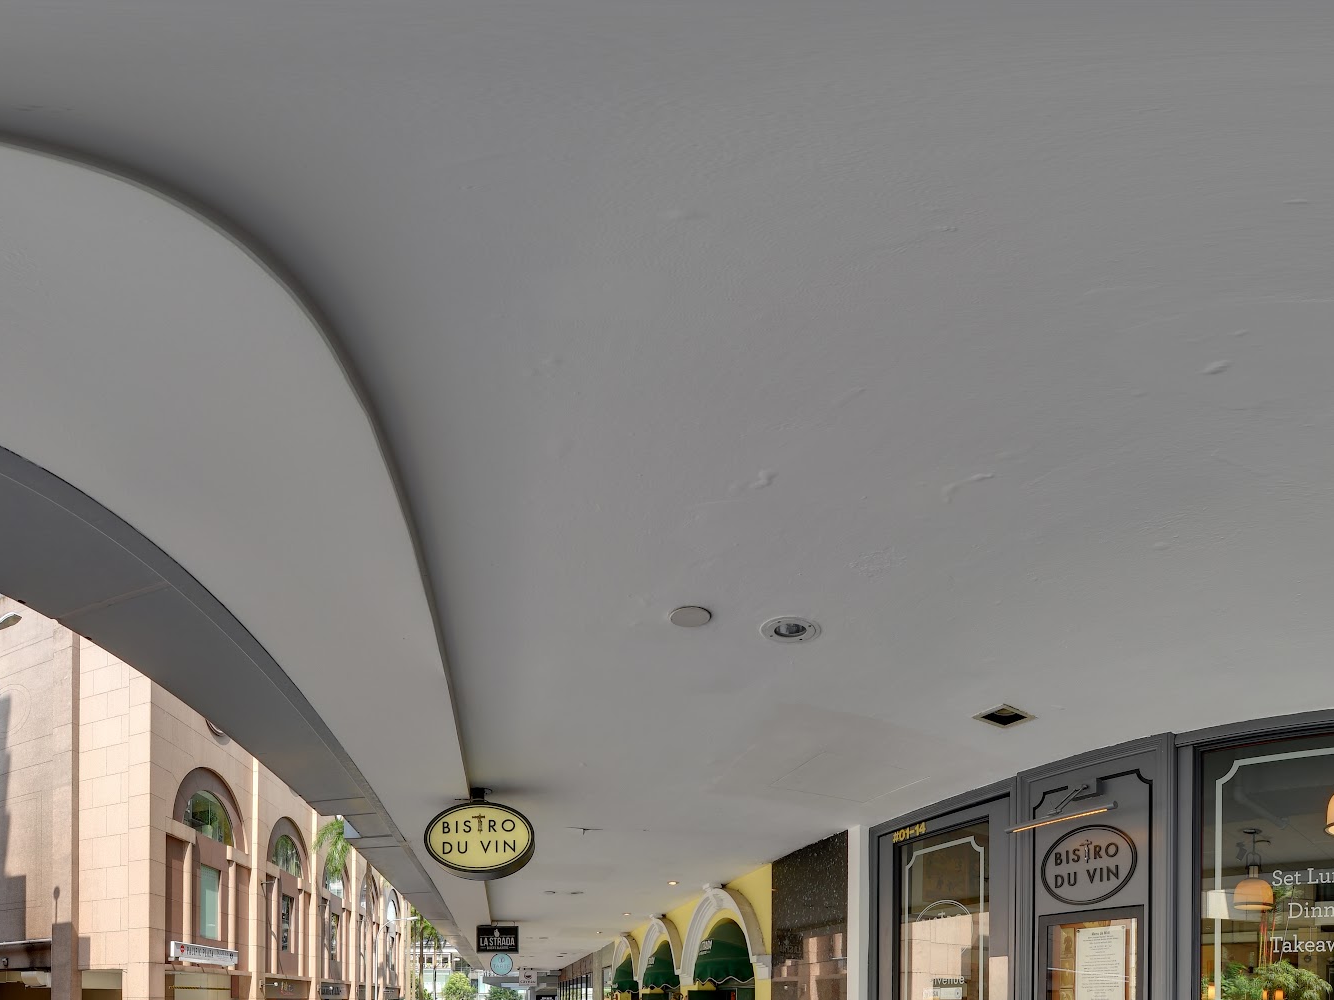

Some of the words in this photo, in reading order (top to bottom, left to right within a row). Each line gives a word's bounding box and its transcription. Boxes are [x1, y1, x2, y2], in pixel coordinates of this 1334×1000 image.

[442, 813, 516, 834] BISTRO
[892, 822, 926, 843] #01-14
[442, 841, 468, 854] DU
[480, 840, 516, 853] VIN
[1054, 839, 1119, 867] BISTRO
[1054, 872, 1077, 889] DU
[1086, 865, 1119, 884] VIN
[1271, 869, 1302, 886] Set
[479, 937, 489, 947] LA
[489, 937, 515, 947] STRADA
